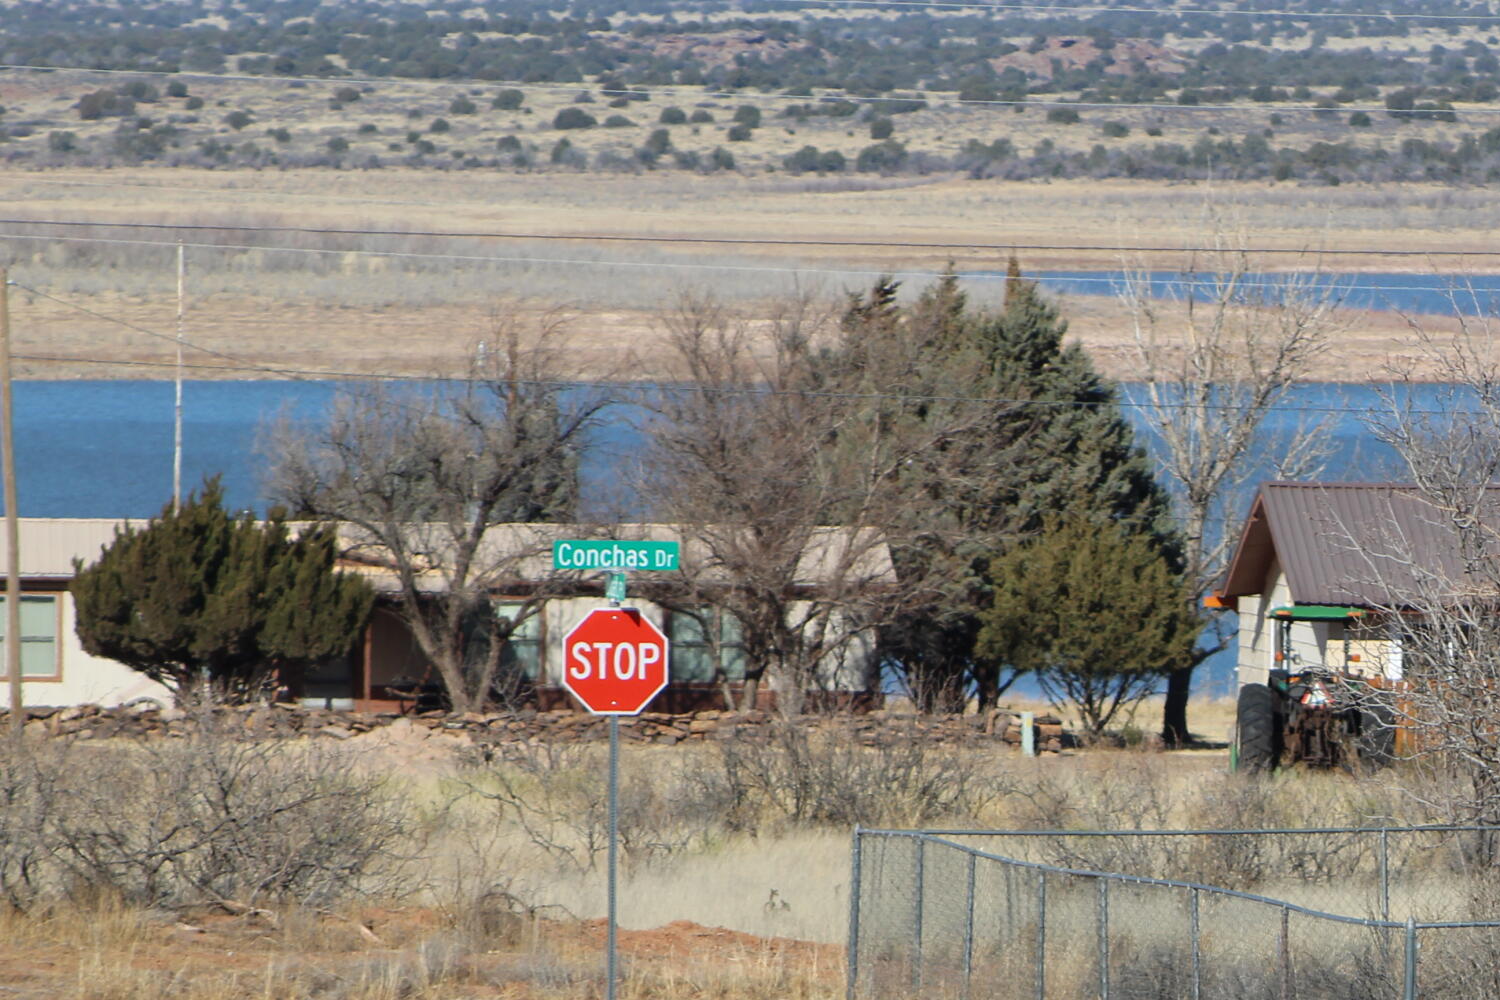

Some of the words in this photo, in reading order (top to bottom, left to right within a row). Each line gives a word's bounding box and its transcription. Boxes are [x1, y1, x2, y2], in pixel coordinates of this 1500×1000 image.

[558, 543, 648, 567] Conchas
[655, 549, 674, 567] Dr
[570, 641, 660, 680] STOP
